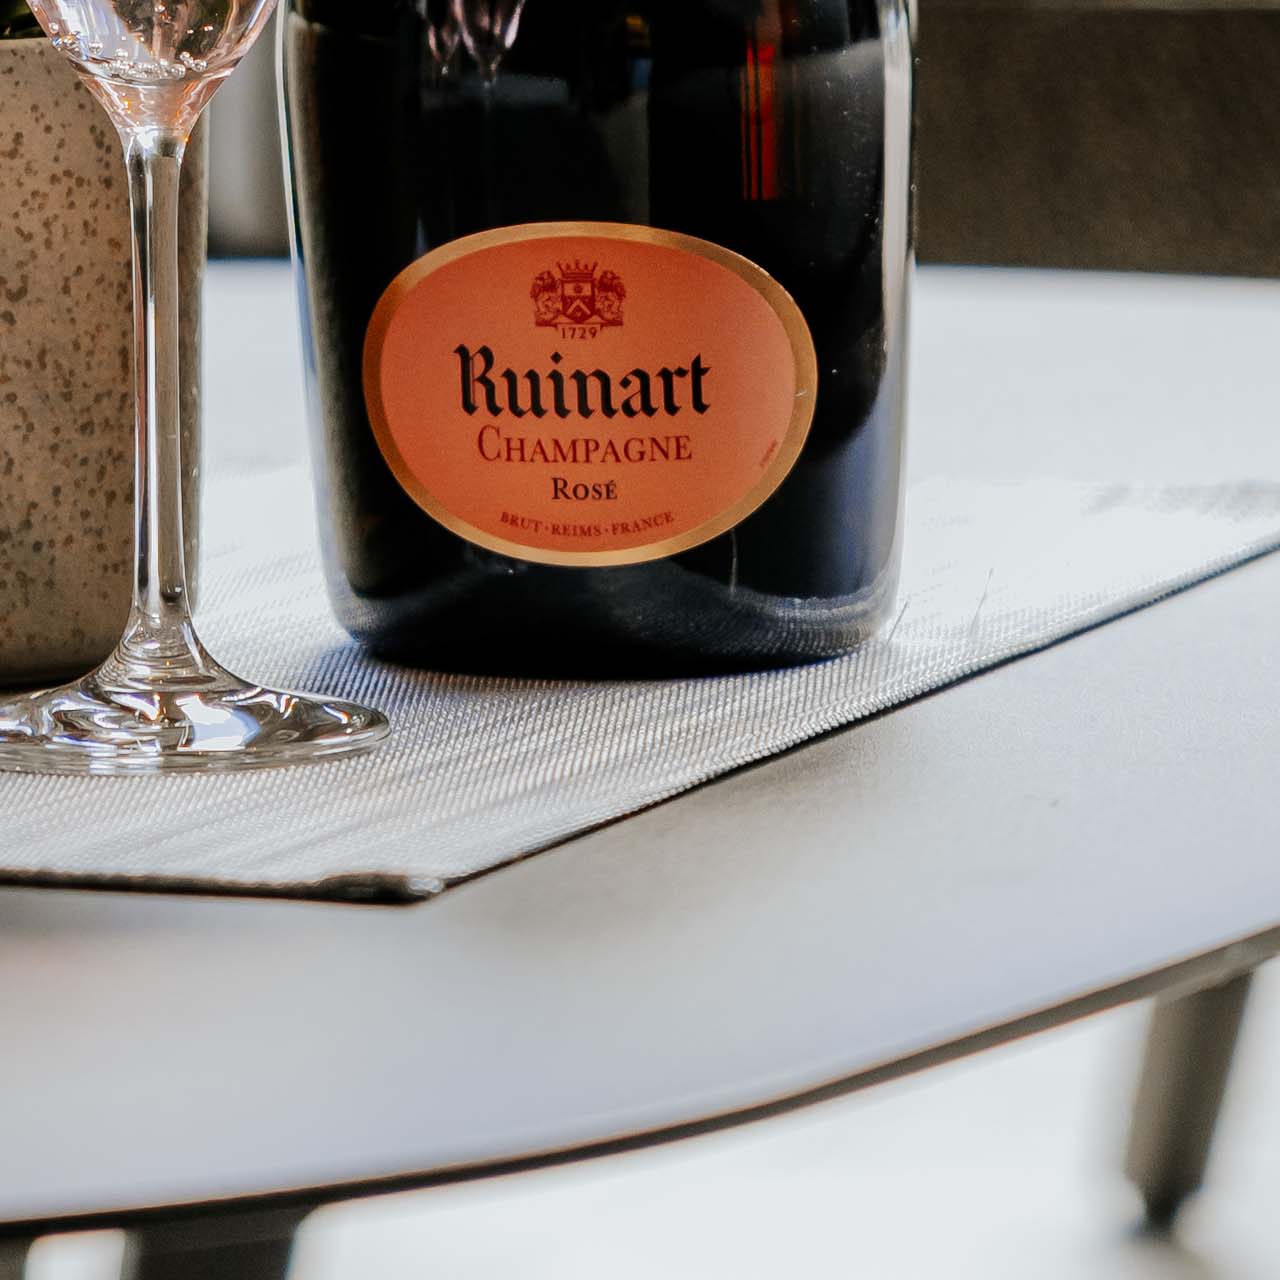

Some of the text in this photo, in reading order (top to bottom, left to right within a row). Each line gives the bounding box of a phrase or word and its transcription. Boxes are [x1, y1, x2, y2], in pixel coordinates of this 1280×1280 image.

[561, 326, 598, 340] 1729
[453, 343, 712, 419] Ruinart
[477, 424, 693, 463] CHAMPAGNE
[500, 511, 675, 537] BRUT REIMS FRANCE
